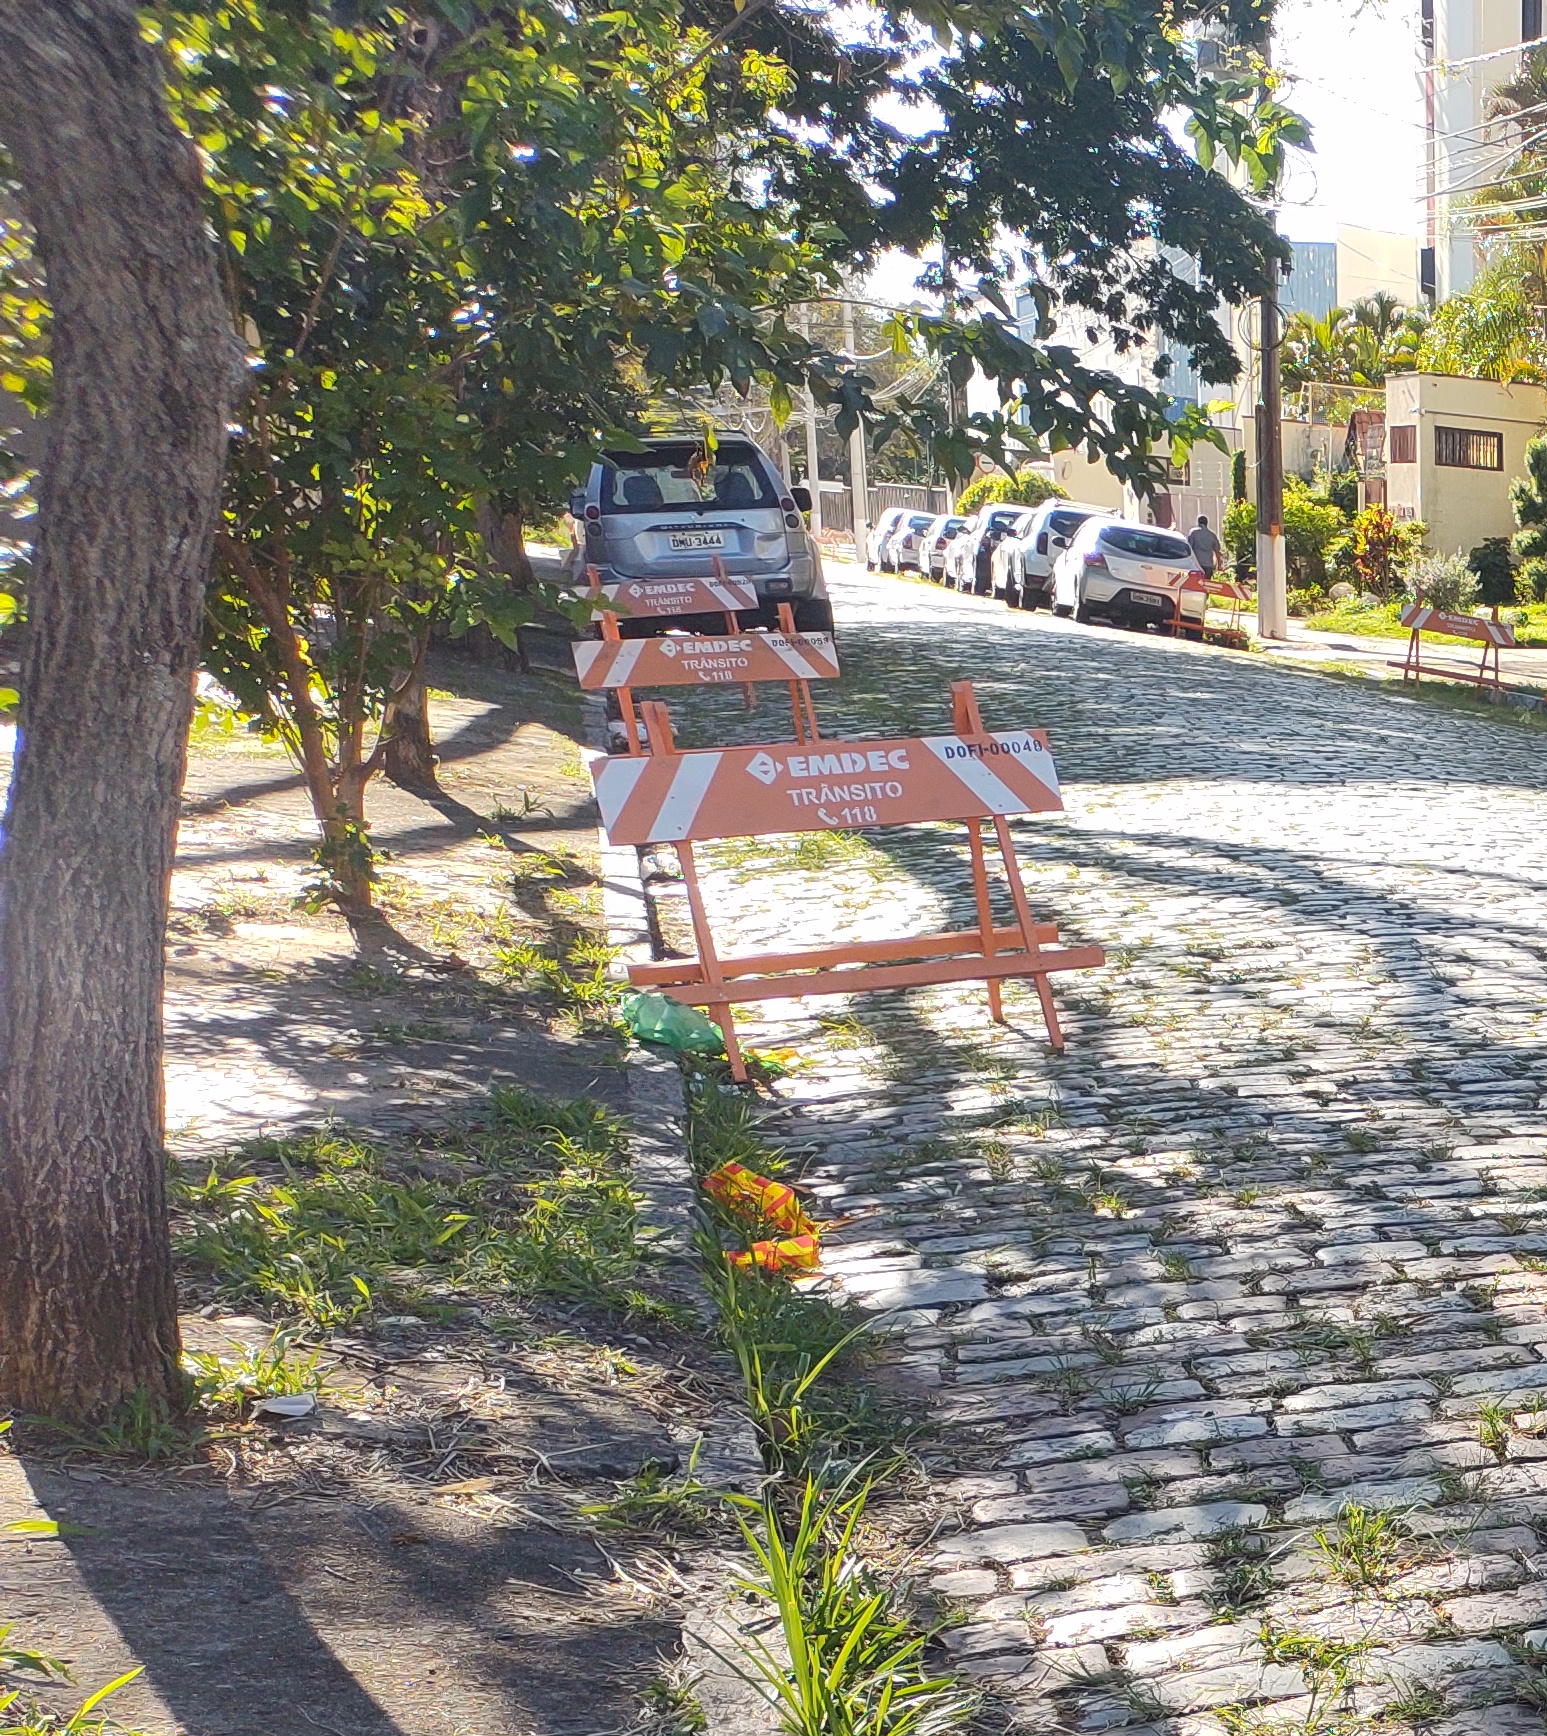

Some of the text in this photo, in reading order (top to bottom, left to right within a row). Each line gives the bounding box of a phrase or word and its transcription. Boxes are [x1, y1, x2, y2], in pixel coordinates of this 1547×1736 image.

[645, 582, 696, 595] EMDEC
[682, 639, 753, 654] EMDEC
[681, 657, 749, 670] TRÂNSITO
[711, 671, 733, 680] 118
[786, 749, 910, 777] EMDEC
[786, 780, 903, 807] TRÂNSITO
[841, 805, 877, 824] 118
